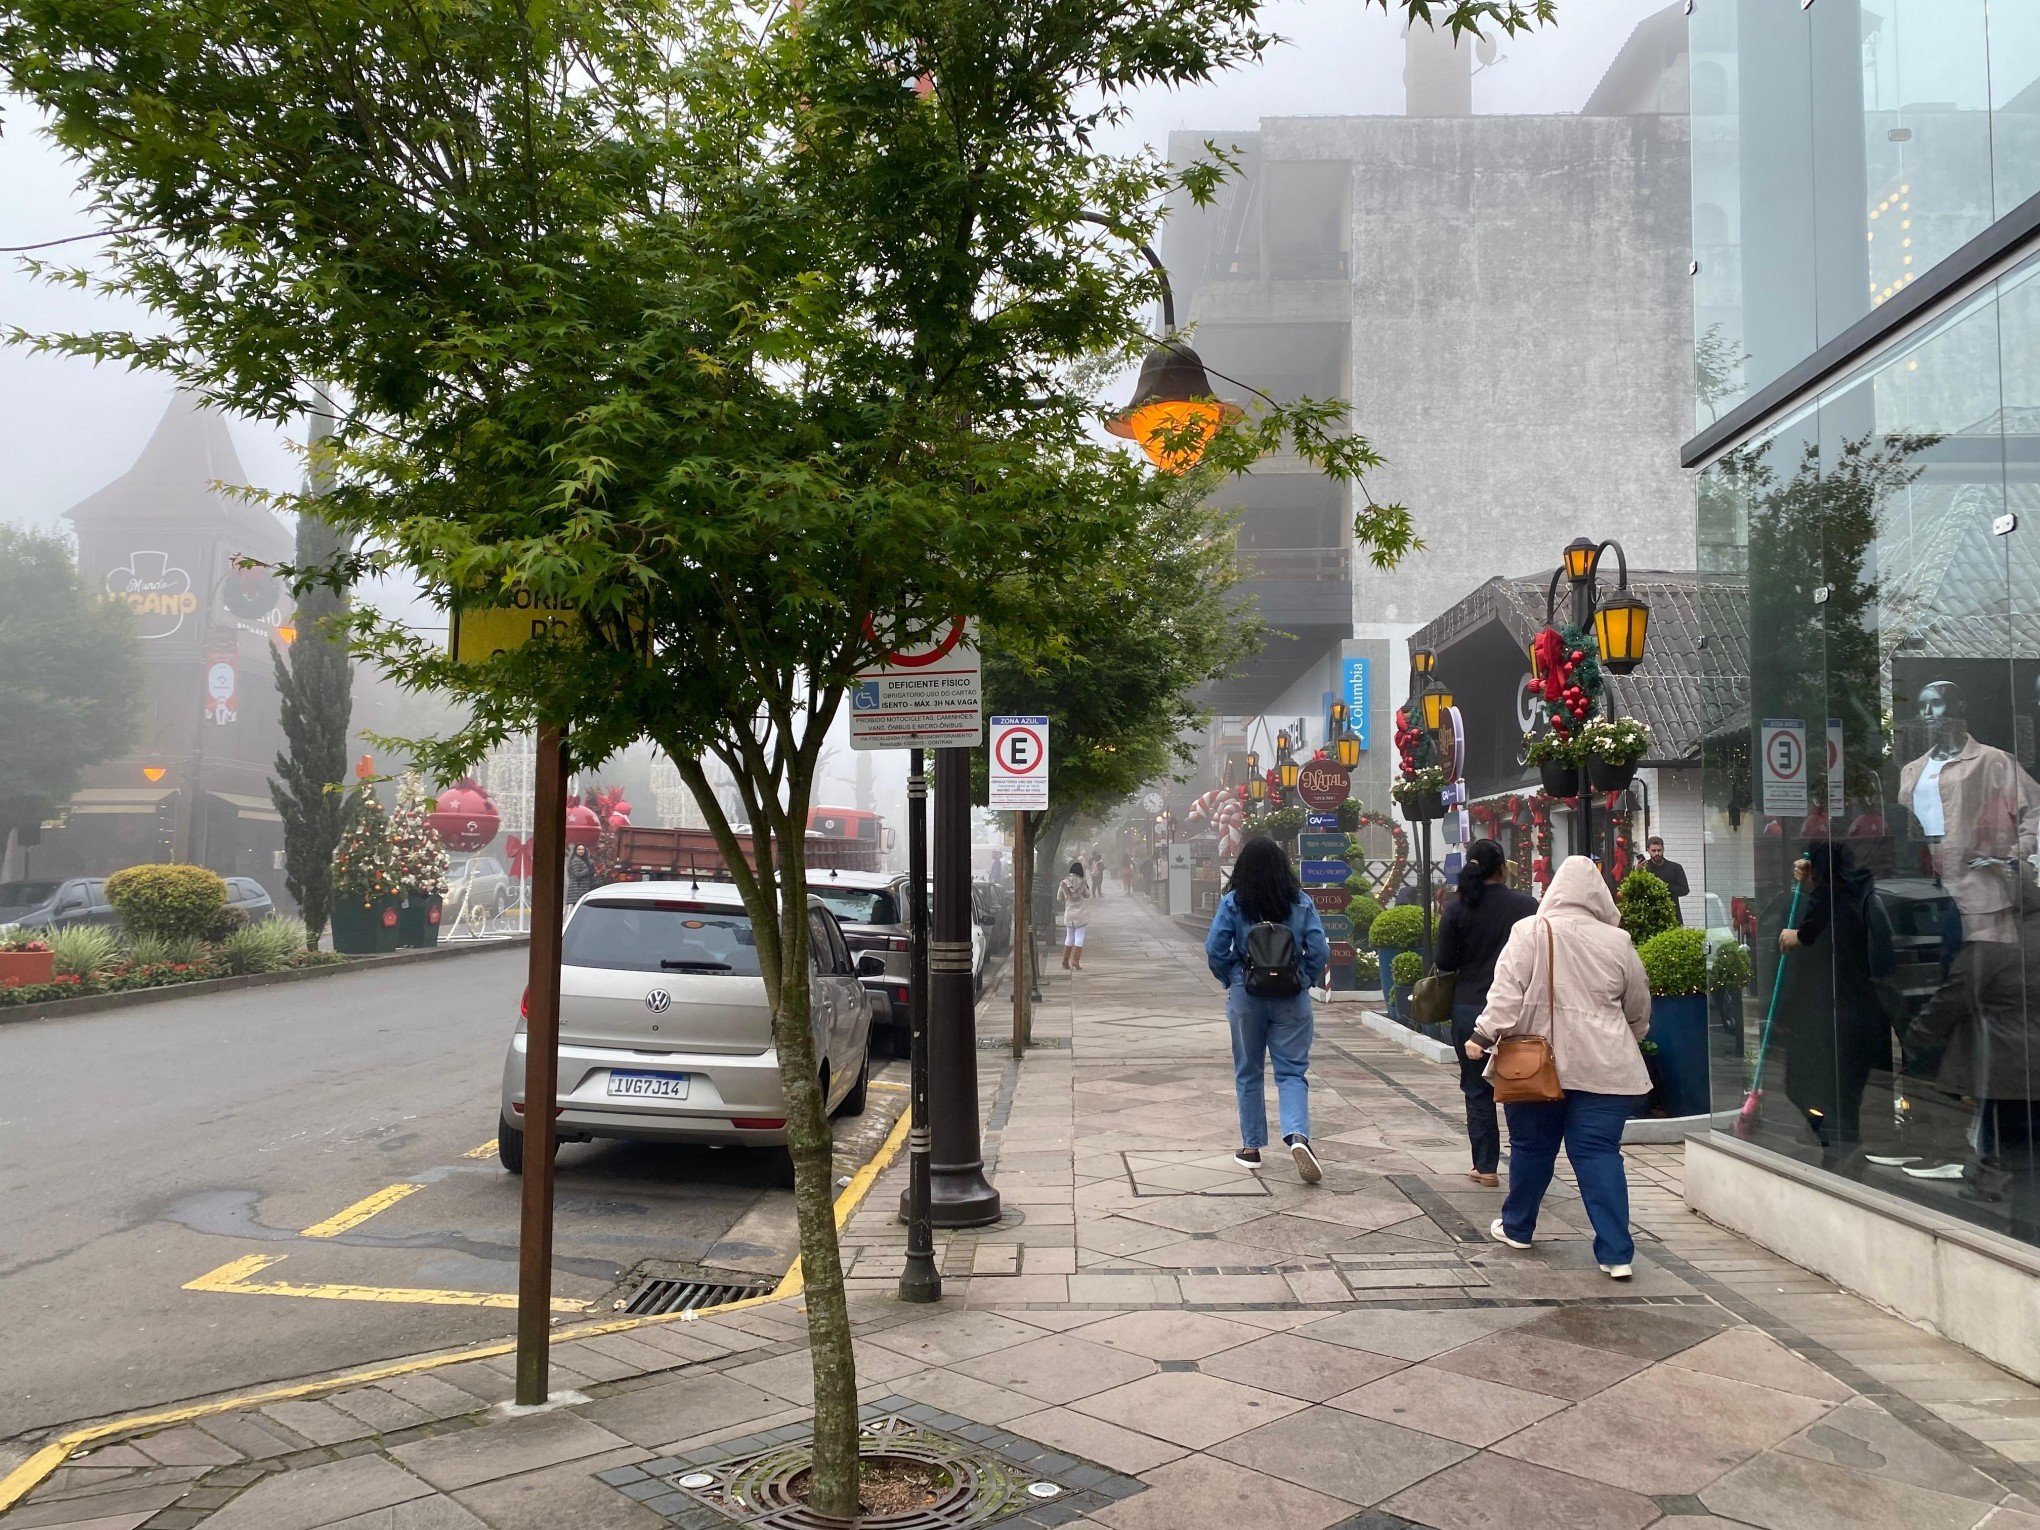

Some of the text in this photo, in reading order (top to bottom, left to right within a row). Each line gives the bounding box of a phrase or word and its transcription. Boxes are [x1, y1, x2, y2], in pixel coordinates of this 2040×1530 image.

[888, 677, 970, 689] DEFICIENTE FÍSICO
[883, 691, 925, 699] OBRIGATÓRIO
[951, 688, 977, 696] CARTÃO
[1349, 663, 1363, 730] Columbia
[881, 701, 908, 709] ISENTO
[957, 698, 978, 706] VAGA
[1011, 737, 1028, 765] E
[1302, 769, 1348, 792] NATAL
[614, 1078, 680, 1096] IVG7J14
